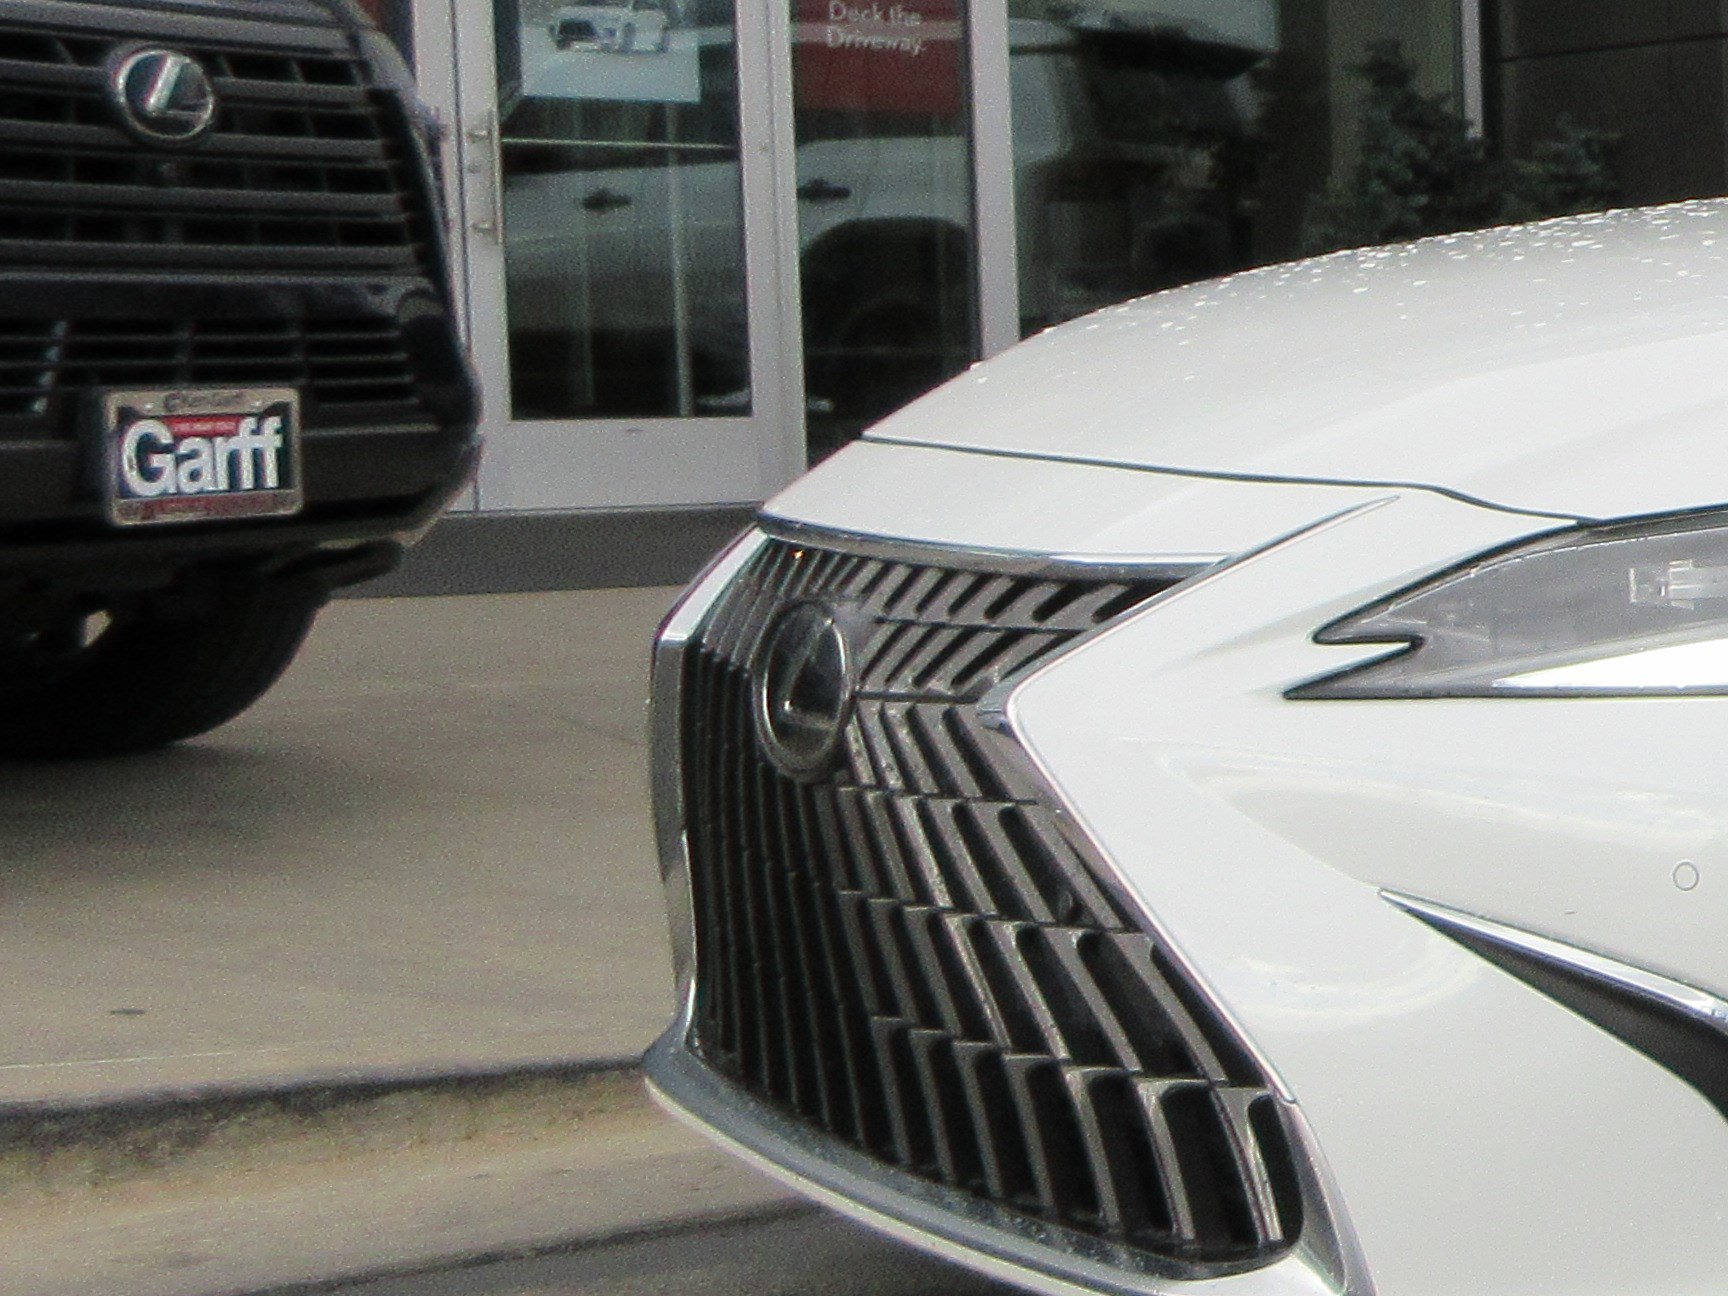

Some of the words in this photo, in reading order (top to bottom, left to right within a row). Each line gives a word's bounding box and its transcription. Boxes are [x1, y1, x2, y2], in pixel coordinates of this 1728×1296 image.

[828, 0, 882, 22] Deck
[889, 3, 921, 26] the
[121, 415, 284, 497] Garff
